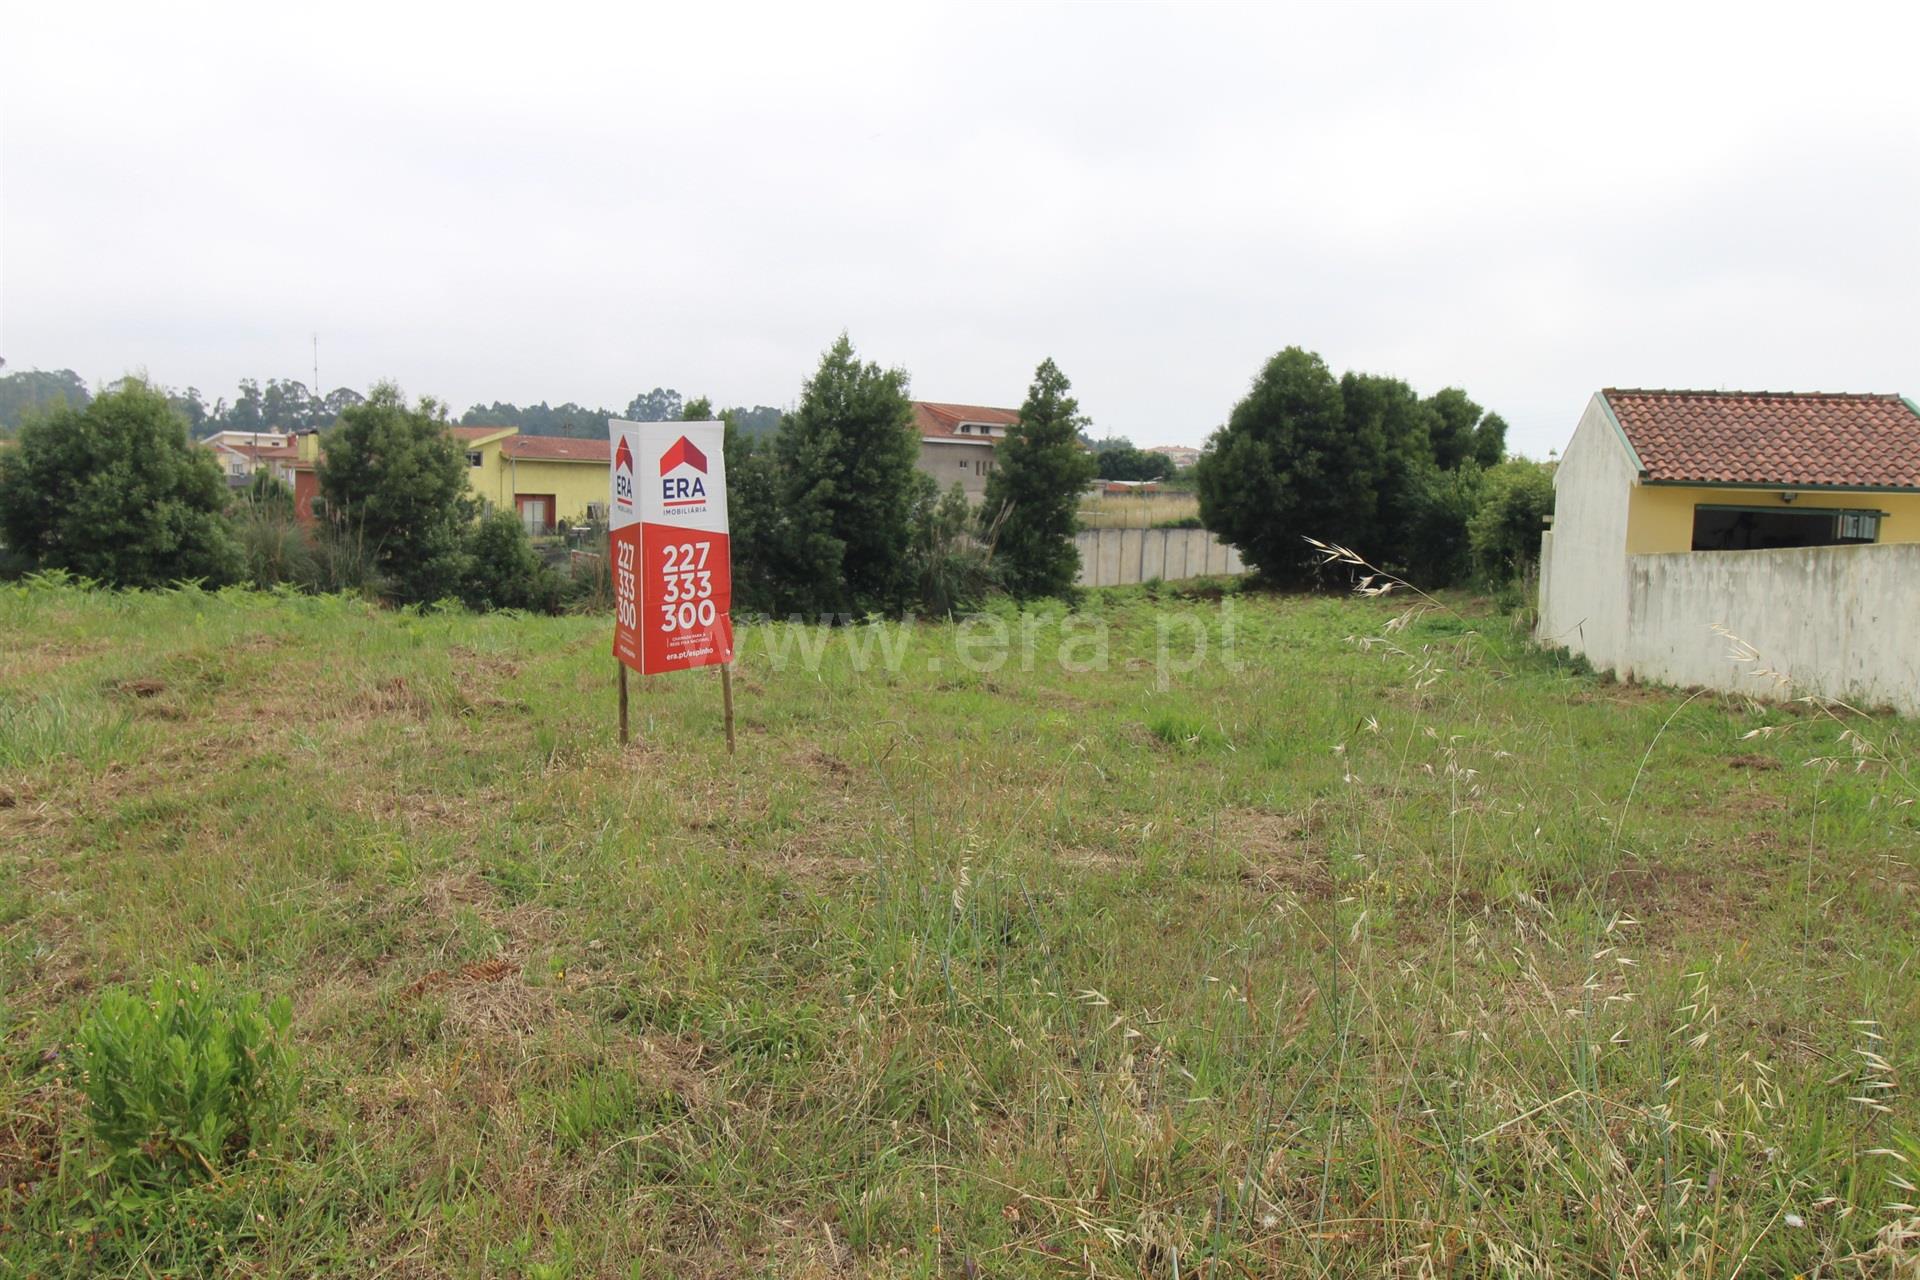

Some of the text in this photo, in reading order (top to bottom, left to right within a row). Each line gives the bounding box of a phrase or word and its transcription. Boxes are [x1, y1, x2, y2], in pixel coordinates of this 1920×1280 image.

[617, 475, 632, 498] ERA
[662, 477, 706, 499] ERA
[663, 507, 707, 516] IMOBILIÁRIA
[617, 539, 634, 571] 227
[662, 541, 710, 573] 227
[618, 568, 634, 601] 333
[663, 570, 712, 603] 333
[618, 595, 636, 630] 300
[661, 599, 716, 632] 300
[666, 647, 714, 661] era.pt/espinho
